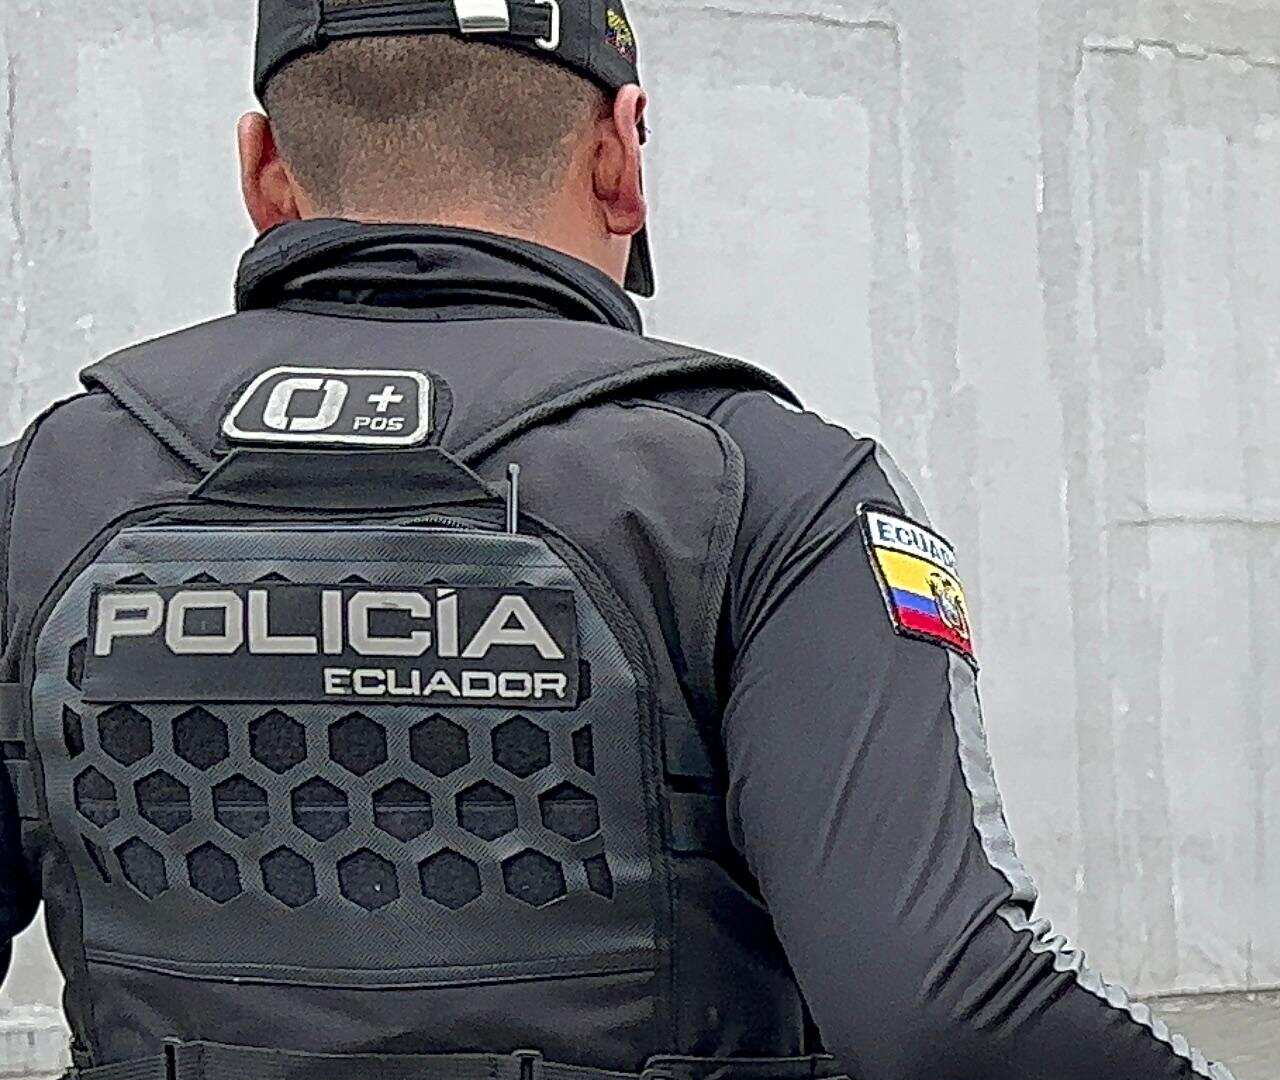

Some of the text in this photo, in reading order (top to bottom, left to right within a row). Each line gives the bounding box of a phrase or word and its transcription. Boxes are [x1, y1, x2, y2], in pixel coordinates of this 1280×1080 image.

[353, 416, 405, 431] POS
[94, 588, 566, 659] POLICÍA
[323, 667, 567, 699] ECUADOR
